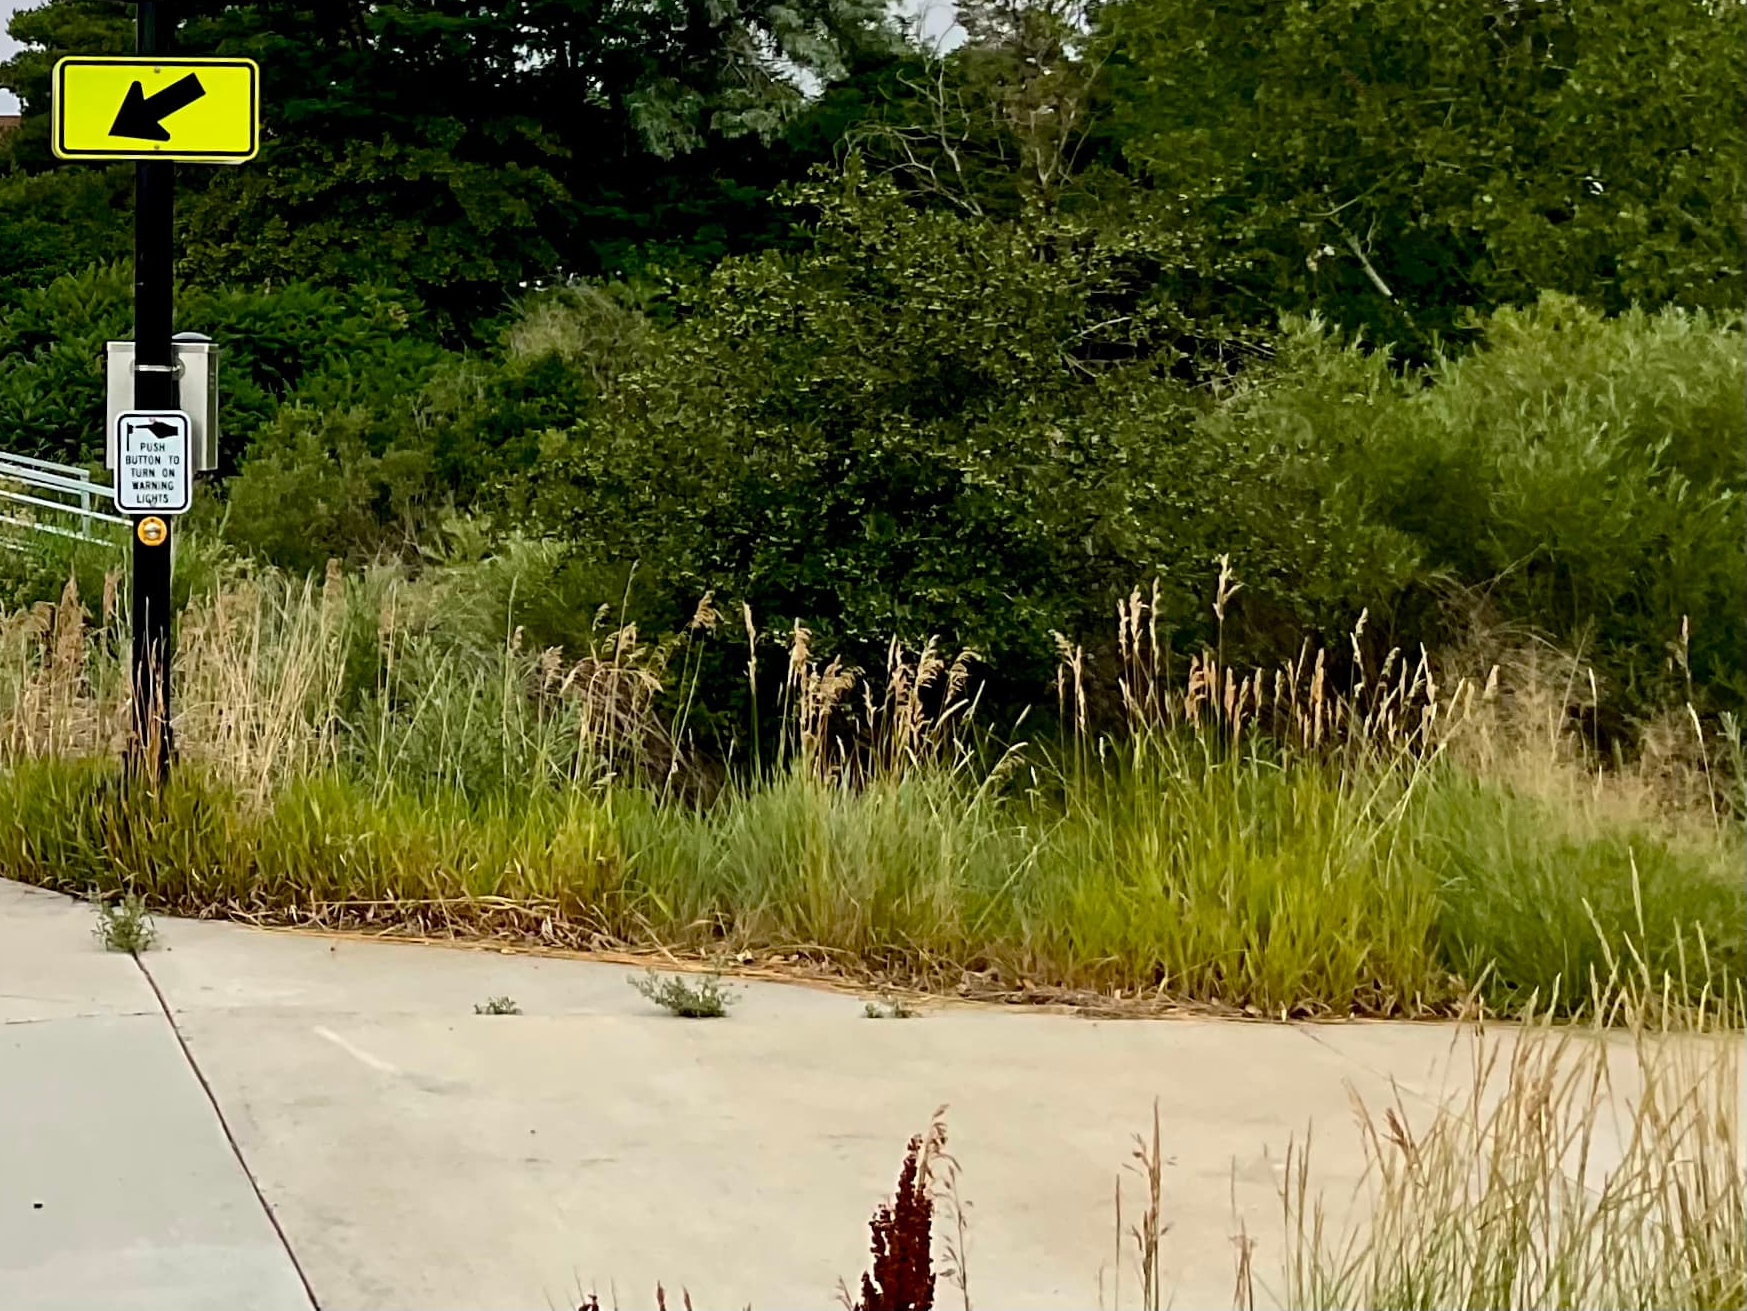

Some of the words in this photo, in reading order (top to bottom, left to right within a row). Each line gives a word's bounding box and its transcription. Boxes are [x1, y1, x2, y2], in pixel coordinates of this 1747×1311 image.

[140, 442, 165, 451] PUSH
[125, 455, 161, 465] BUTTON
[169, 455, 180, 465] TO
[131, 468, 155, 477] TURN
[162, 468, 175, 477] ON
[132, 481, 174, 490] WARNING
[136, 494, 169, 503] LIGHTS
